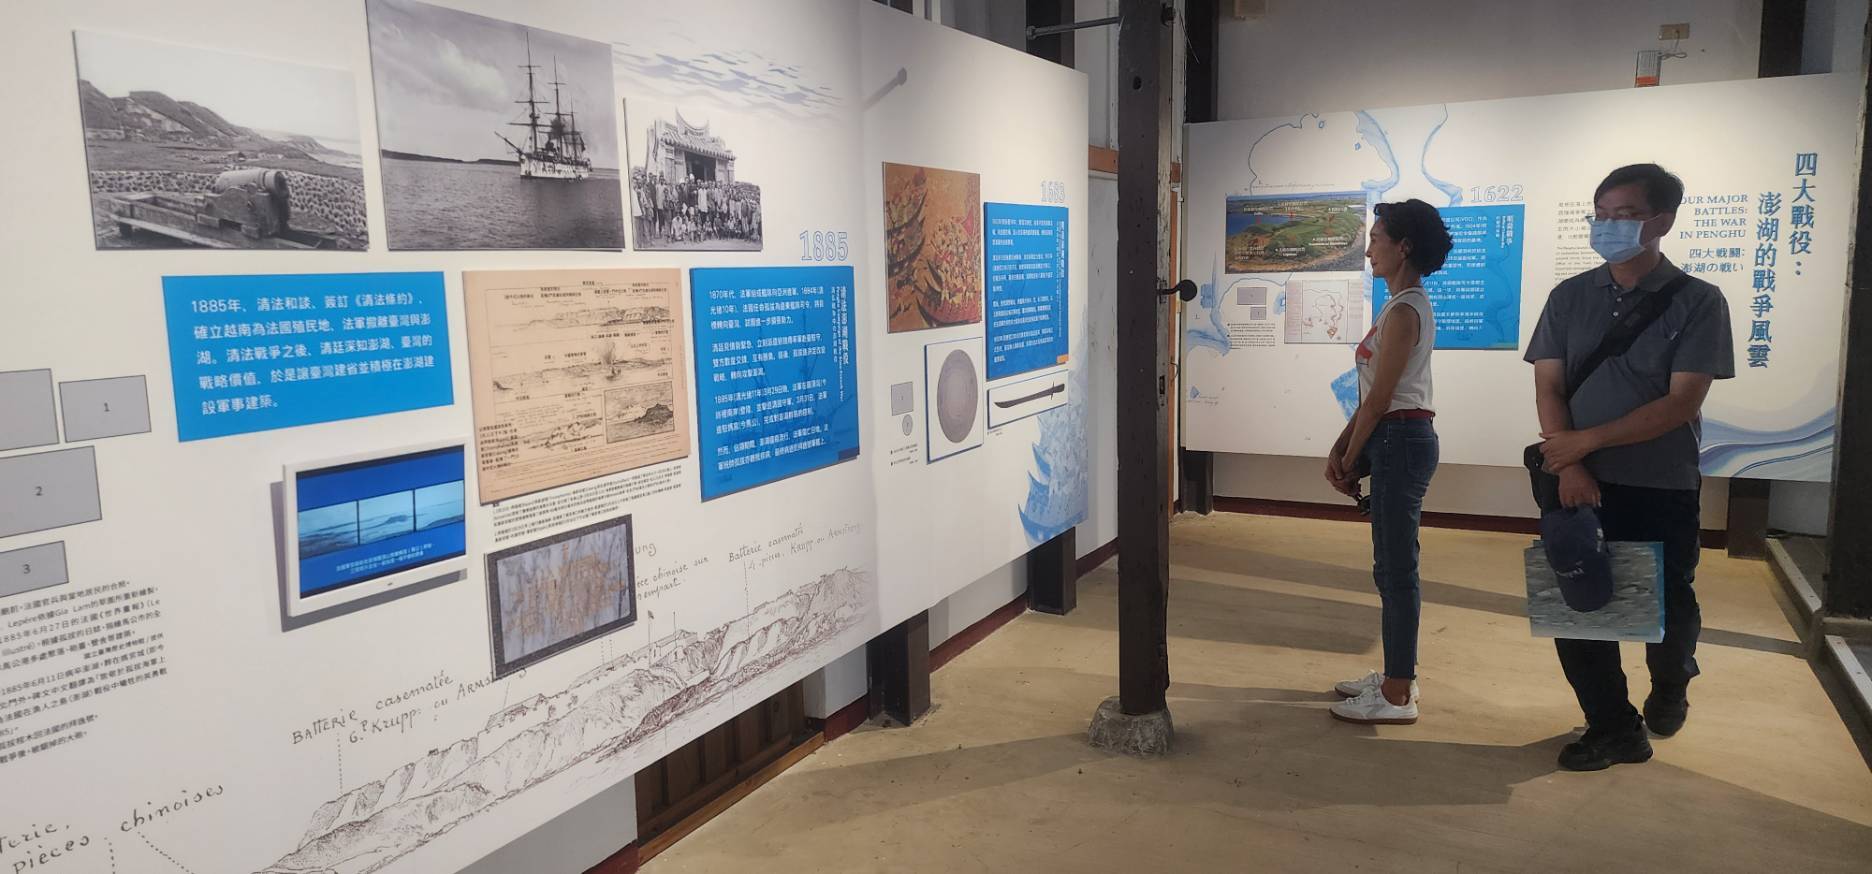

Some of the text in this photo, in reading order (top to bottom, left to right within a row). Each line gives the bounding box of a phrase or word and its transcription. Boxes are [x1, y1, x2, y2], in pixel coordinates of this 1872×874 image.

[1471, 184, 1524, 203] 1622
[1707, 194, 1749, 205] MAJOR
[1695, 206, 1748, 216] BATTLES:
[1694, 218, 1747, 228] THE WAR
[1680, 230, 1747, 240] IN PENGHU
[799, 230, 849, 262] 1885
[1748, 191, 1782, 369] 澎湖的戰爭風雲
[103, 402, 110, 412] 1
[35, 486, 43, 496] 2
[23, 563, 31, 575] 3
